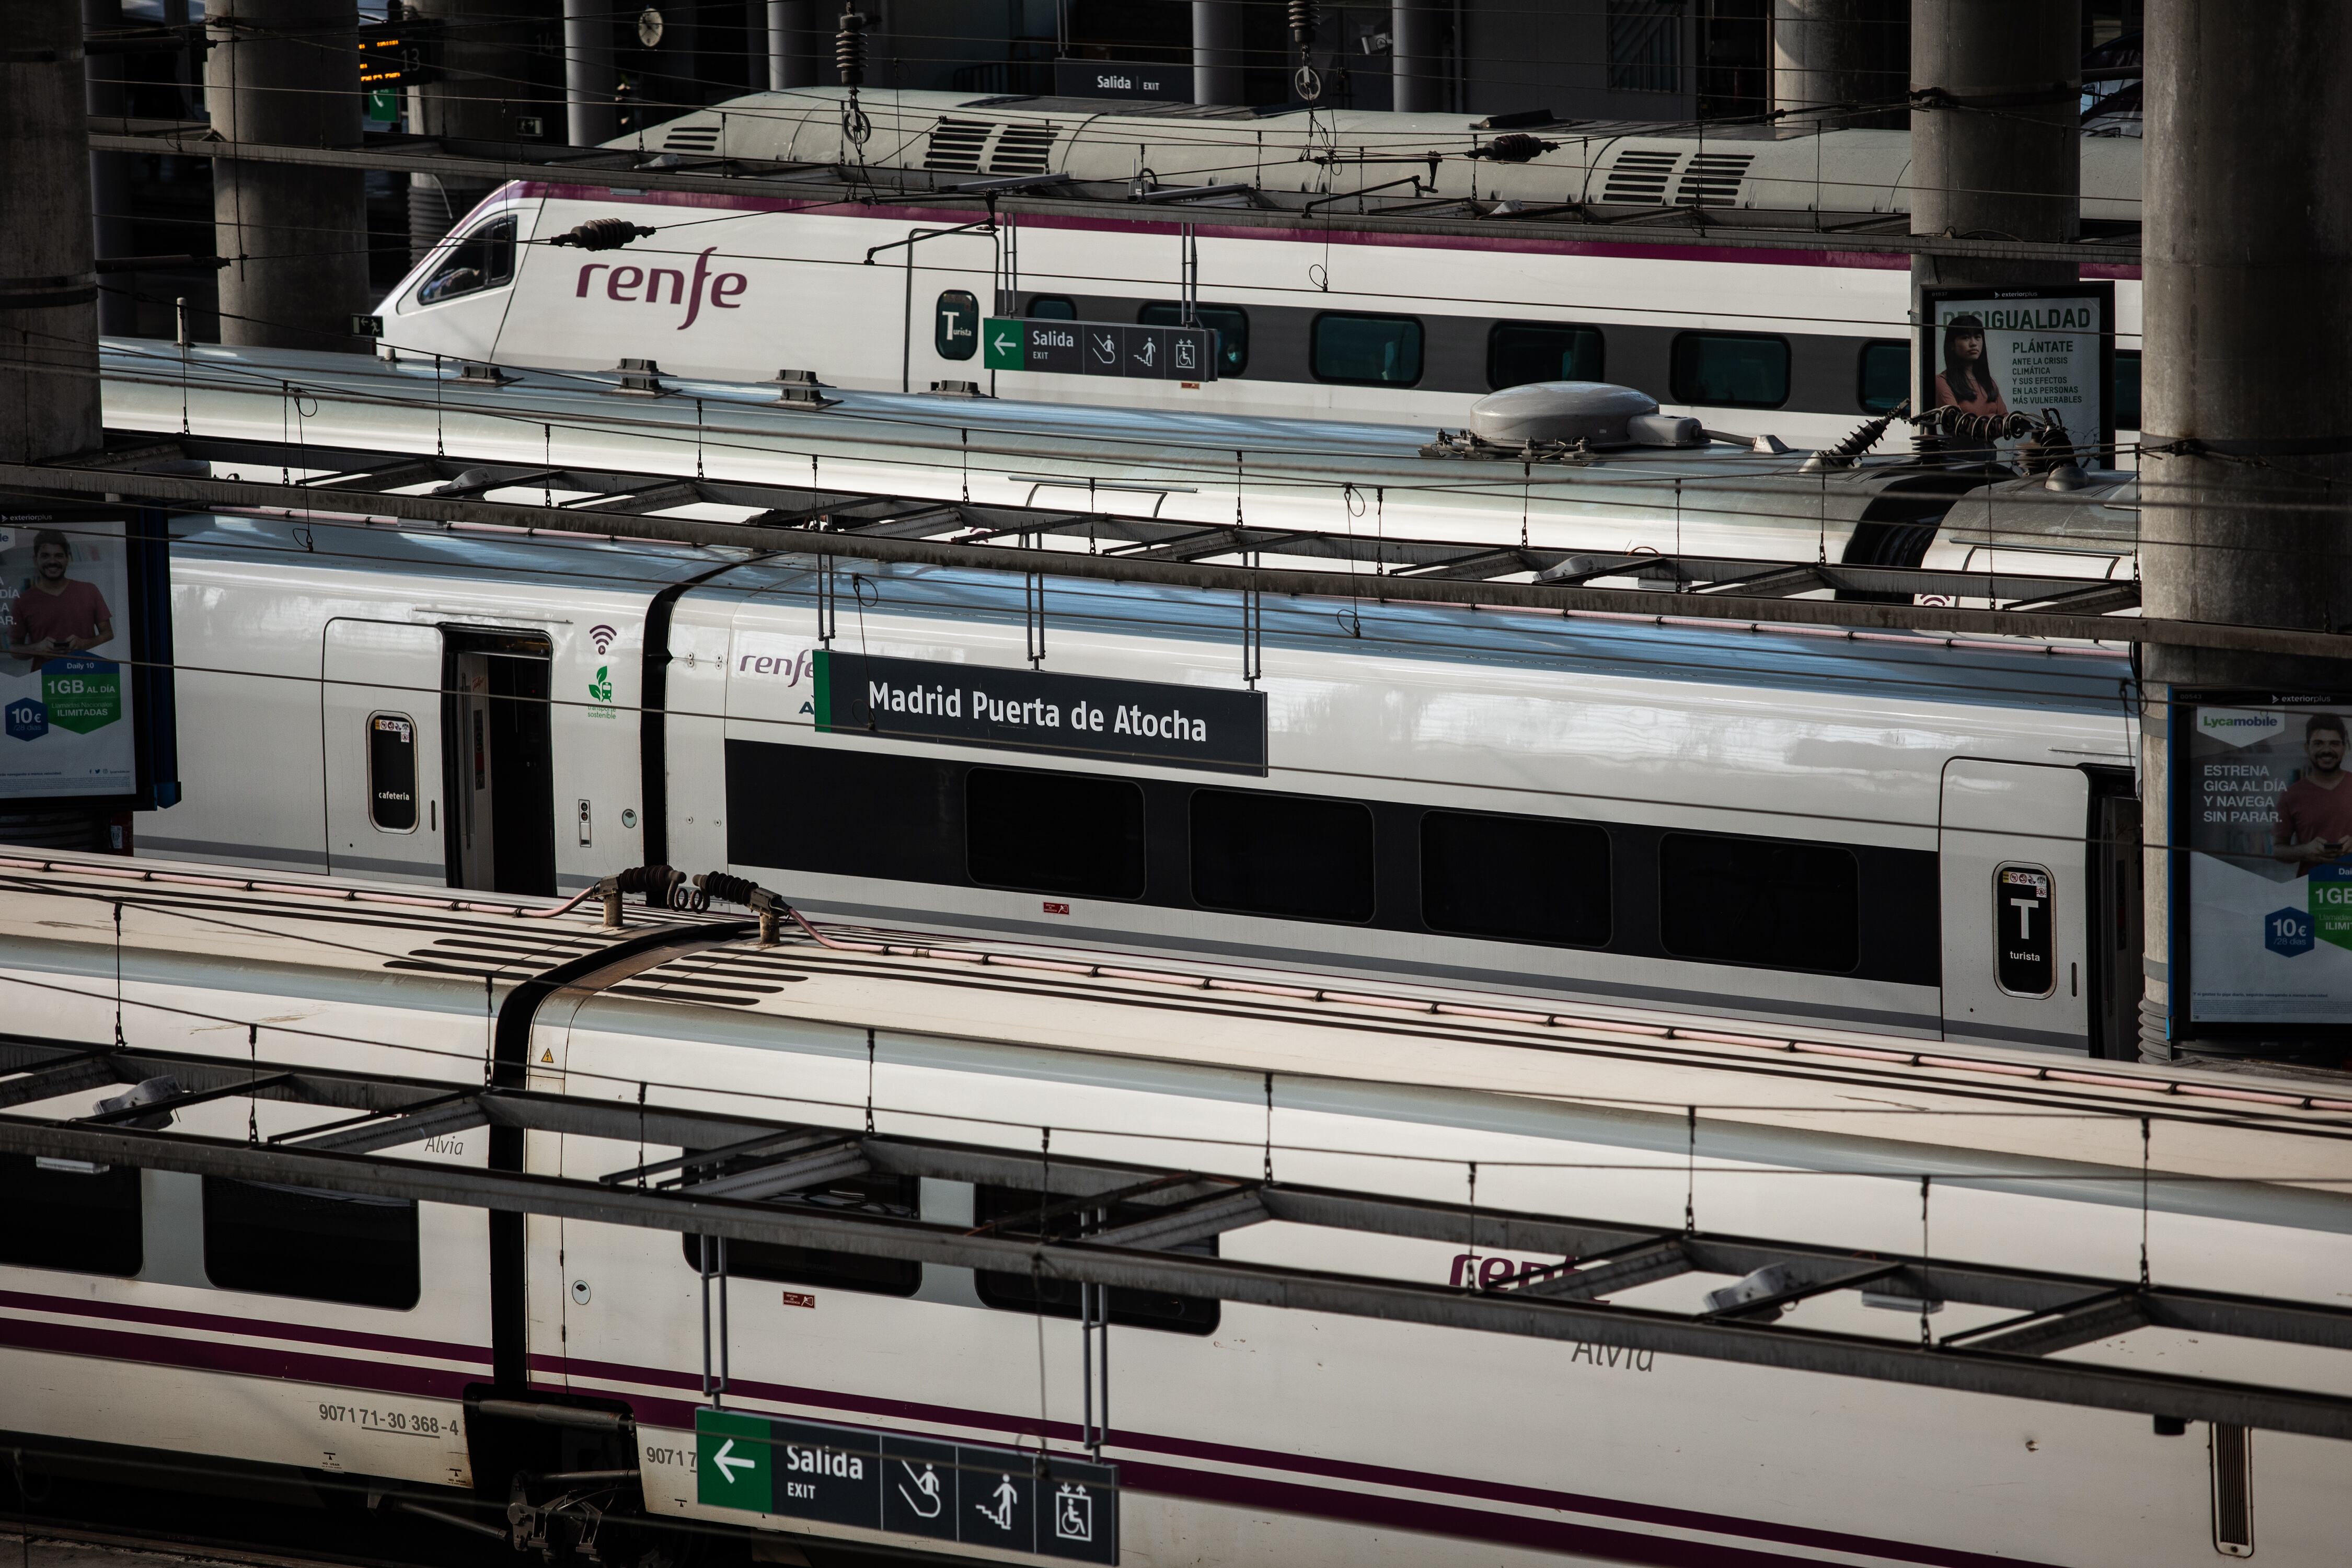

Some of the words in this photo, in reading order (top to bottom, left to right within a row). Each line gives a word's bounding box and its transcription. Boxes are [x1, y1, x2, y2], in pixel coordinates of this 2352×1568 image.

[401, 48, 420, 72] 13
[1097, 75, 1132, 89] Salida
[1143, 82, 1160, 90] EXIT
[576, 247, 747, 330] renfe
[1943, 308, 2090, 331] DIGUALDAD
[1033, 330, 1074, 347] Salida
[2013, 339, 2073, 353] PLÁNTATE
[1033, 351, 1048, 360] EXIT
[2013, 366, 2050, 375] CLIMÁTICA
[2013, 395, 2028, 405] MÁS
[2030, 396, 2082, 404] VULNERABLES
[48, 680, 84, 695] 1GB
[100, 684, 116, 693] DÍA
[2281, 694, 2331, 703] exteriorplus
[57, 708, 108, 717] ILIMITADAS
[869, 681, 961, 718] Madrid
[973, 691, 1060, 728] Puerta
[1071, 701, 1104, 731] de
[1114, 705, 1207, 742] Atocha
[2204, 716, 2278, 728] Lycamobile
[2204, 765, 2270, 777] ESTRENA
[2204, 780, 2239, 792] GIGA
[2241, 780, 2260, 792] AL
[2264, 778, 2288, 792] DÍA
[2204, 795, 2213, 807] Y
[2216, 795, 2275, 807] NAVEGA
[2204, 811, 2227, 823] SIN
[2231, 811, 2283, 823] PARAR.
[2010, 897, 2039, 940] T
[2010, 951, 2040, 962] turista
[424, 1135, 464, 1156] Alvia
[786, 1444, 863, 1480] Salida
[787, 1482, 816, 1500] EXIT
